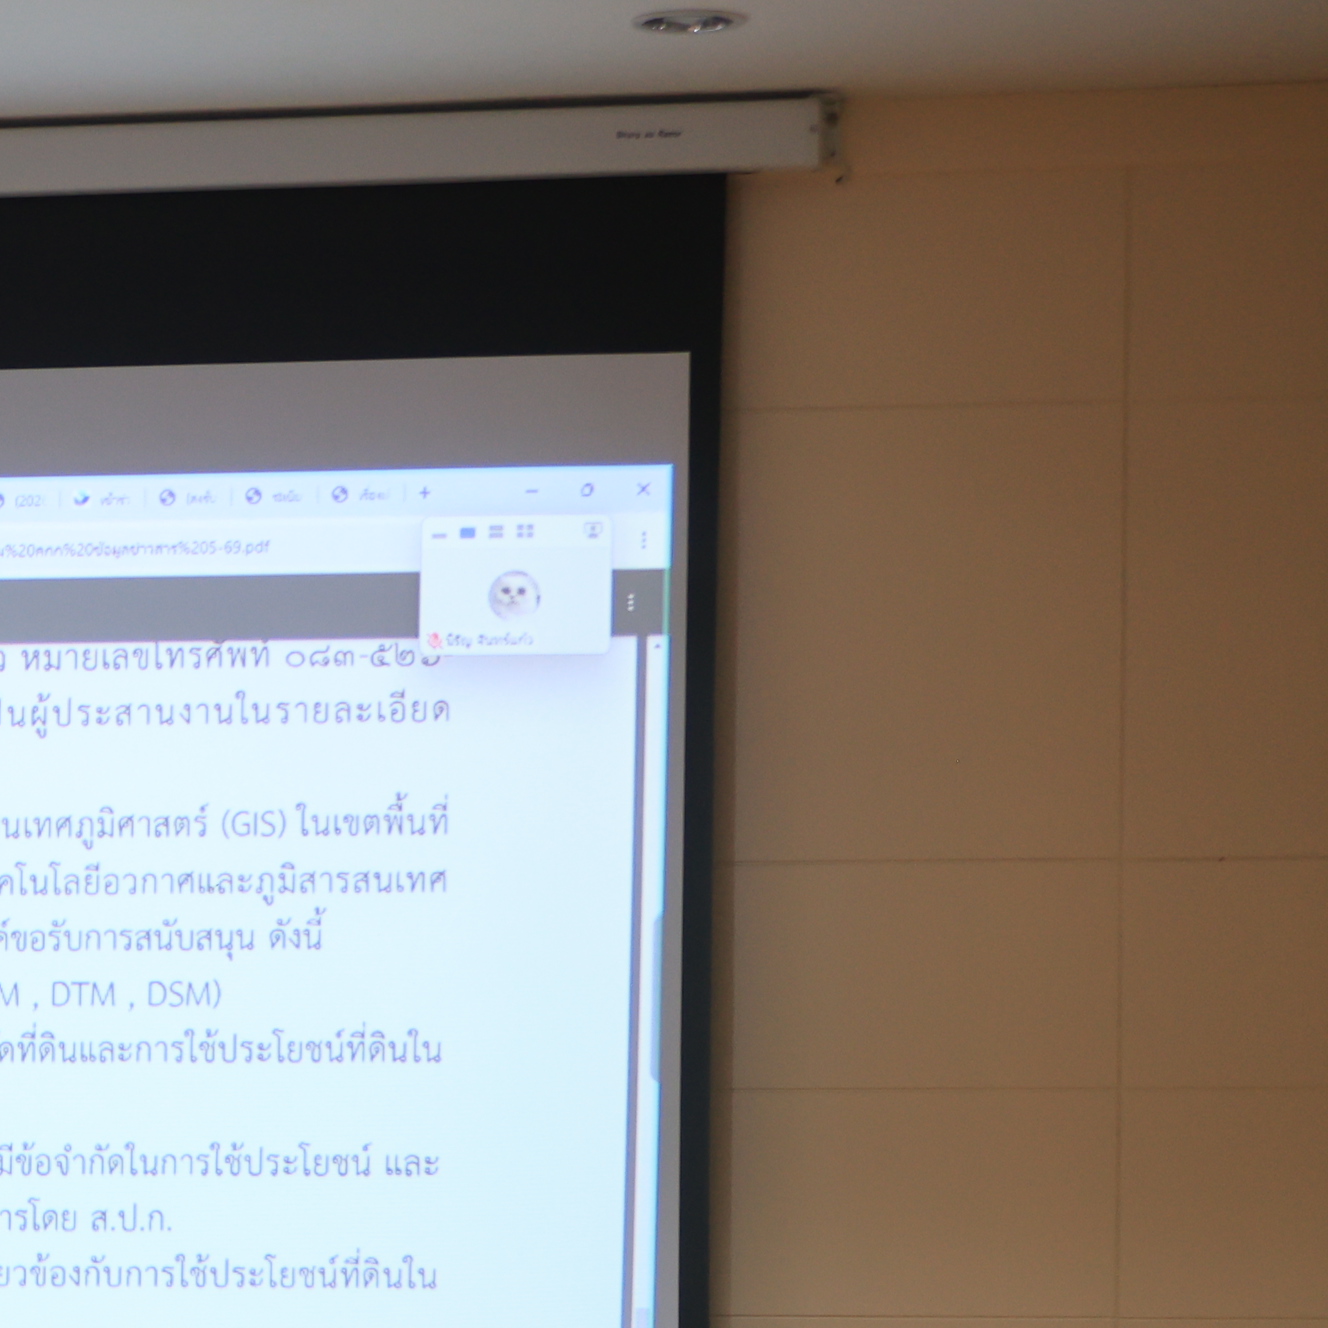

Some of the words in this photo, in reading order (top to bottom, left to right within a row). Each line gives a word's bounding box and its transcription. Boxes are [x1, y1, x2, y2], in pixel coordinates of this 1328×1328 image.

[221, 808, 288, 840] (GIS)
[295, 791, 449, 838] ในเขตพื้นที่
[268, 906, 327, 951] ดังนี้
[51, 980, 117, 1008] DTM
[147, 979, 222, 1010] DSM)
[385, 1154, 440, 1178] และ
[91, 1202, 173, 1234] ส.ป.ก.
